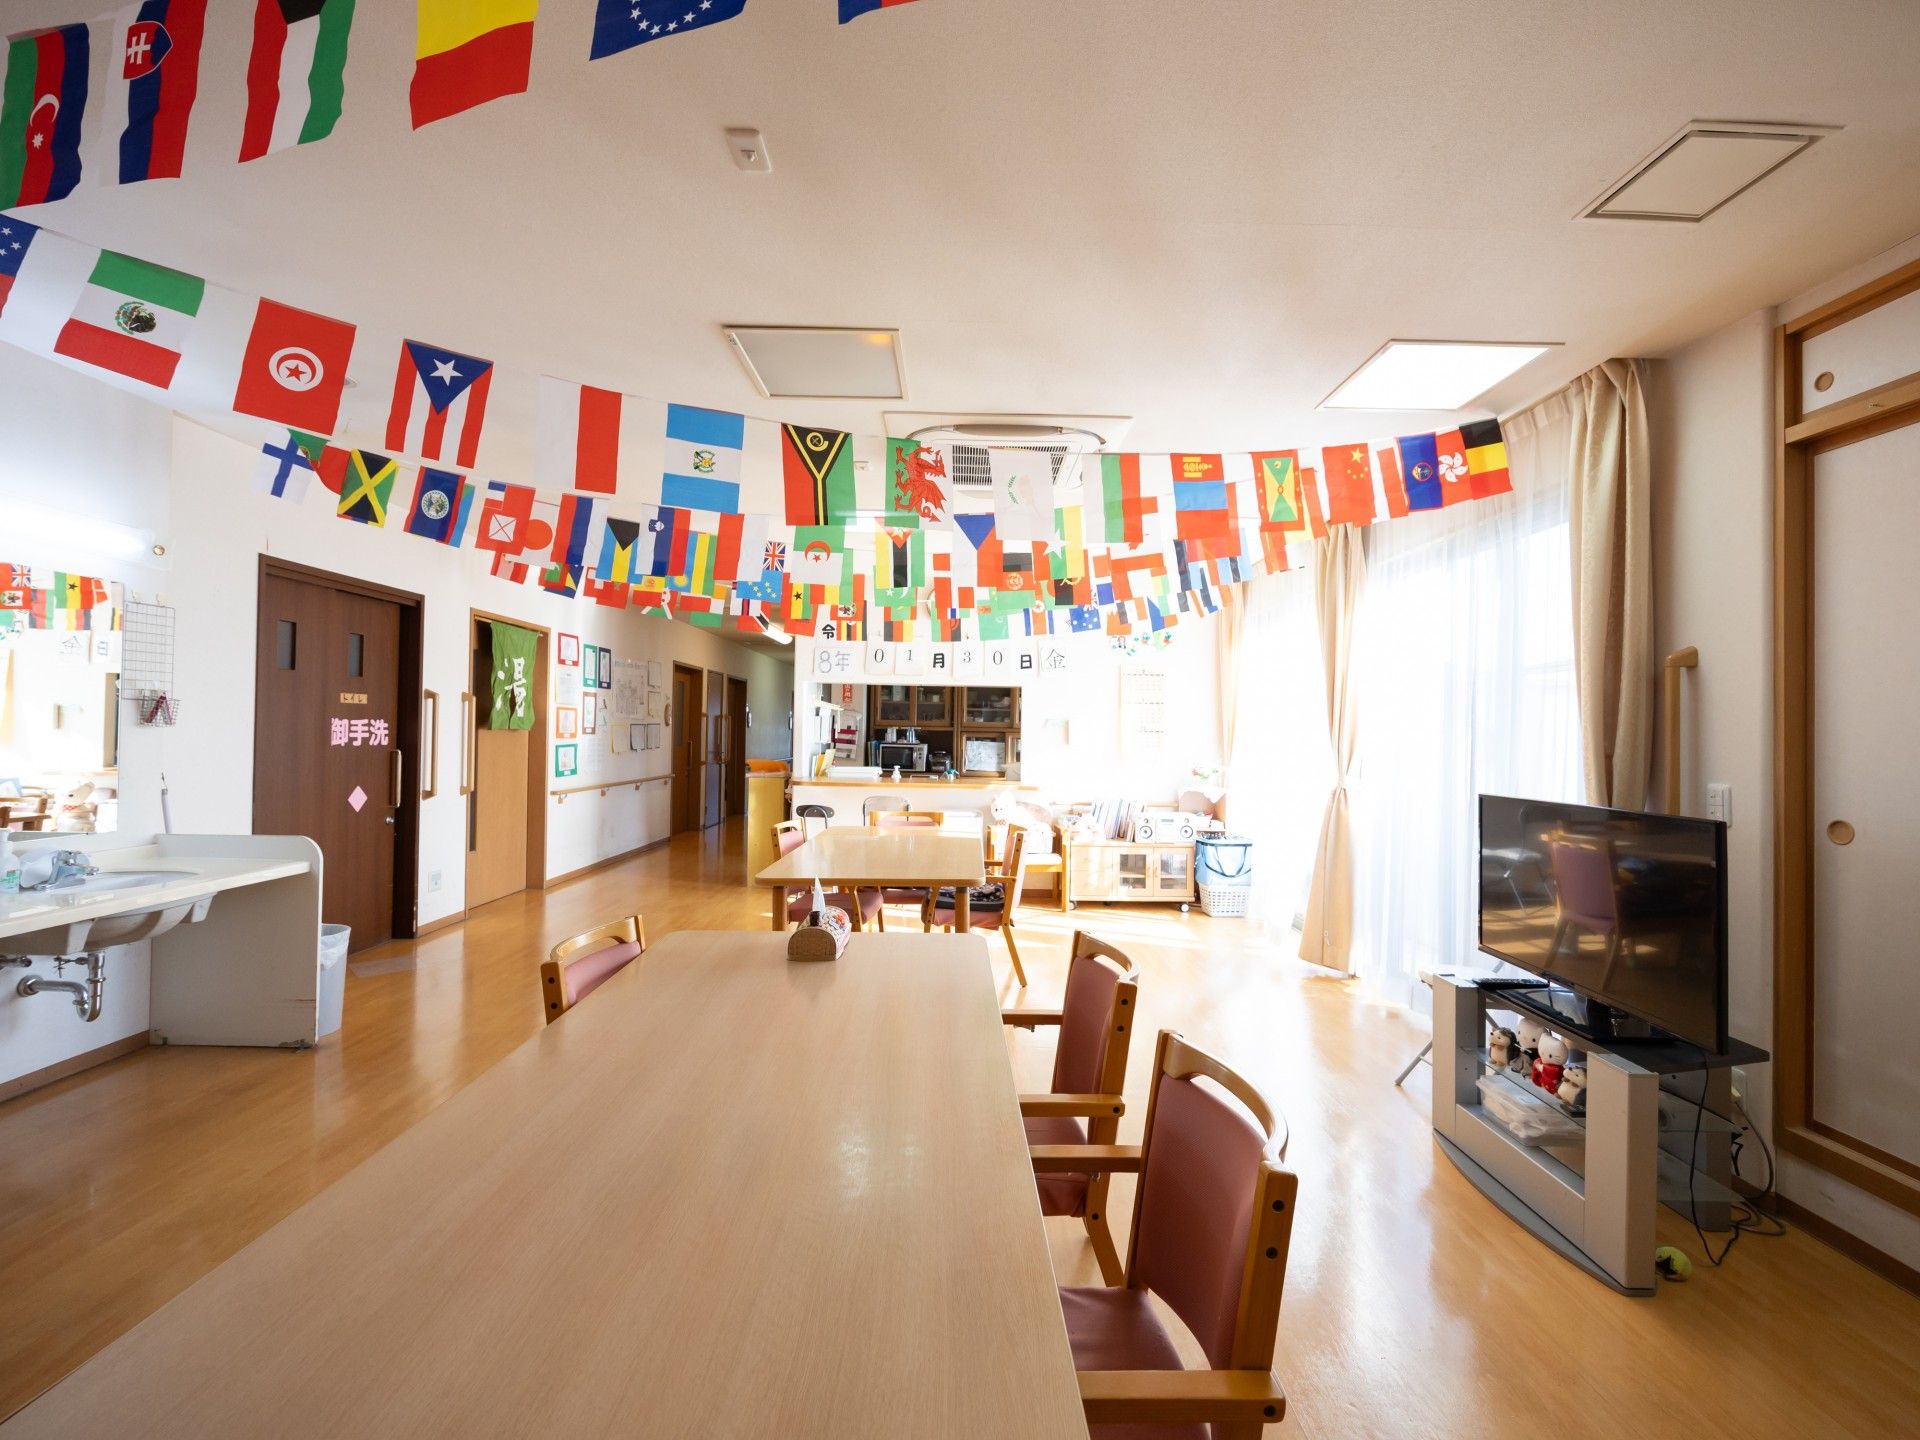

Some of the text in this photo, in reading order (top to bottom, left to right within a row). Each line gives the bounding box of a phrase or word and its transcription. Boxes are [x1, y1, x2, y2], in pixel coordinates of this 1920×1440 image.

[495, 656, 528, 718] 湯
[330, 717, 390, 747] 御手洗
